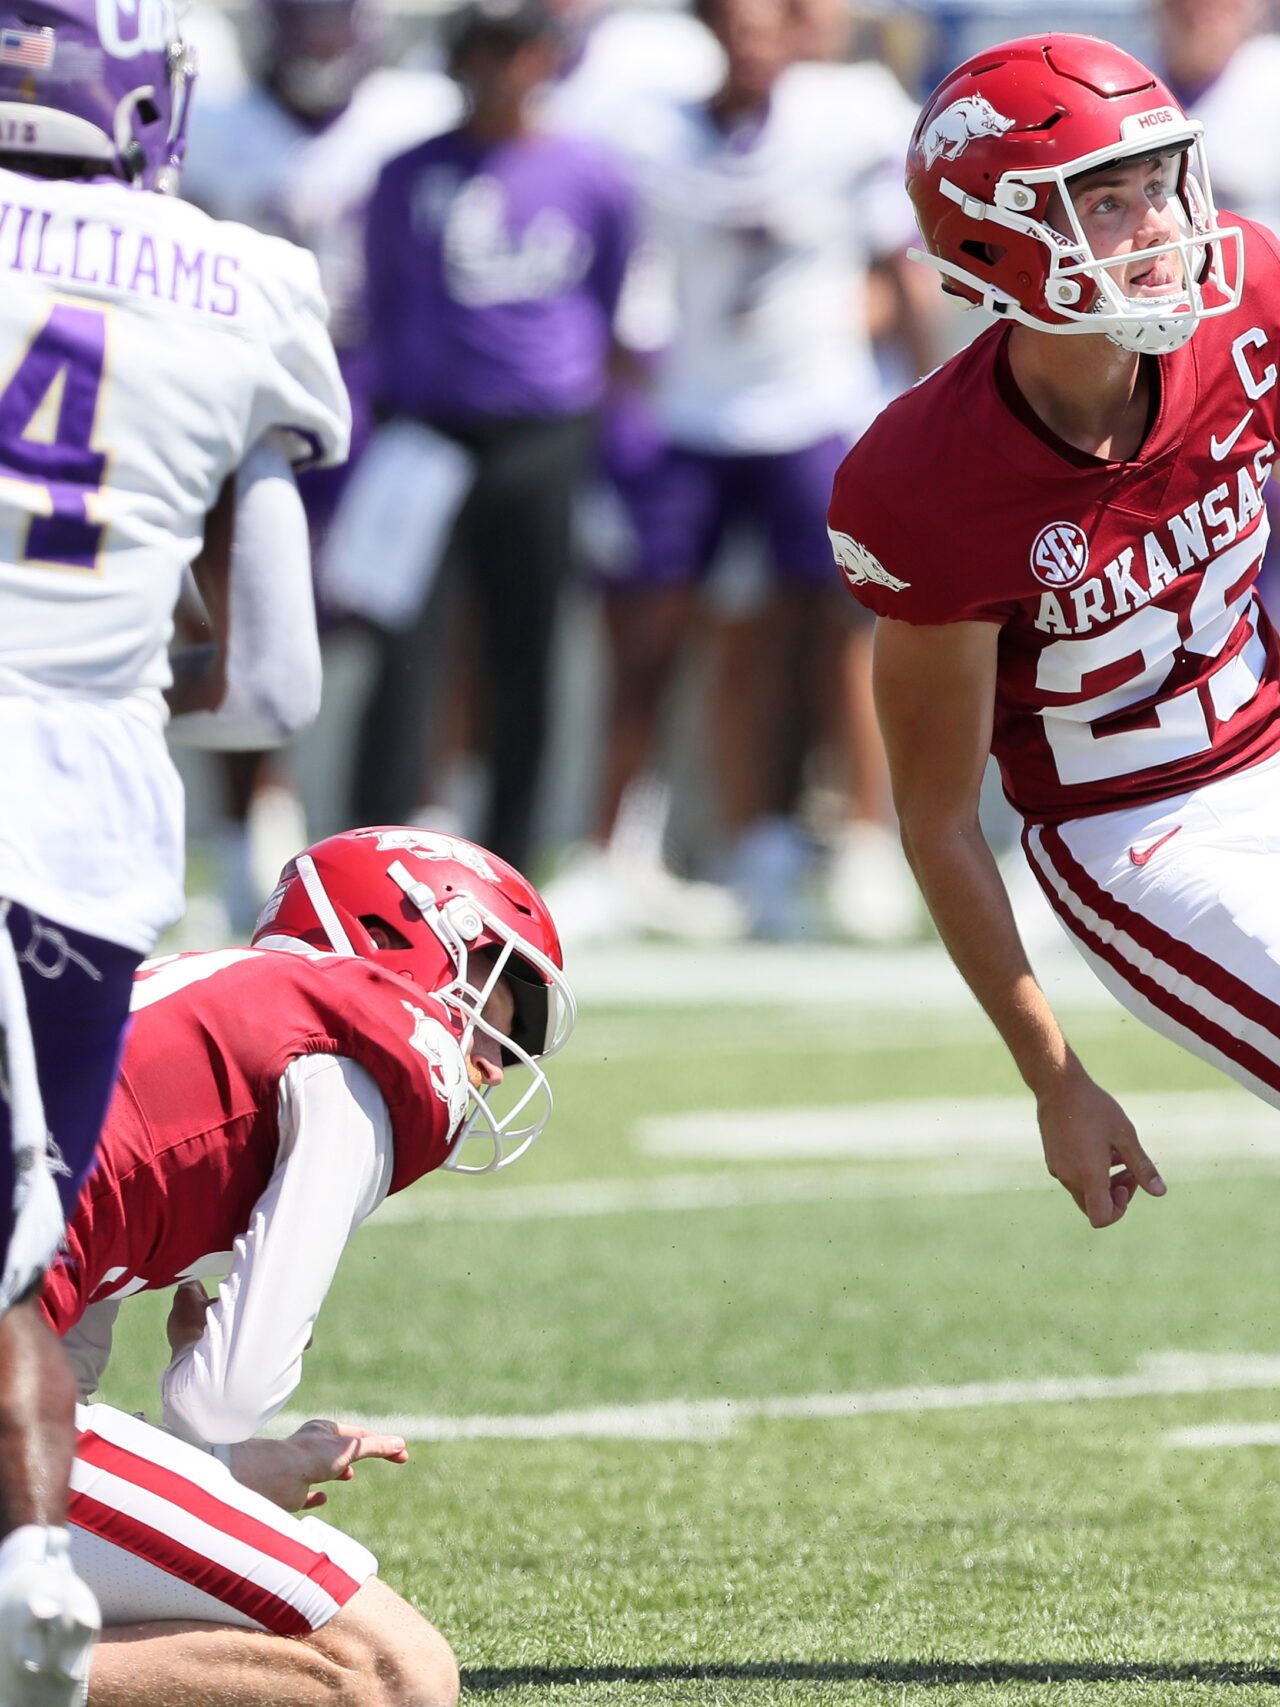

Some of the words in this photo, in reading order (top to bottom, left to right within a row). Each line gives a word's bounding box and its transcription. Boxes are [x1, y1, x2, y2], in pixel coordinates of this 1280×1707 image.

[1137, 110, 1173, 129] HOGS
[0, 203, 240, 316] ILLIAMS
[1231, 326, 1278, 401] C
[0, 298, 112, 577] 4
[1034, 440, 1275, 635] ARKANSAS
[1035, 526, 1084, 583] SEC
